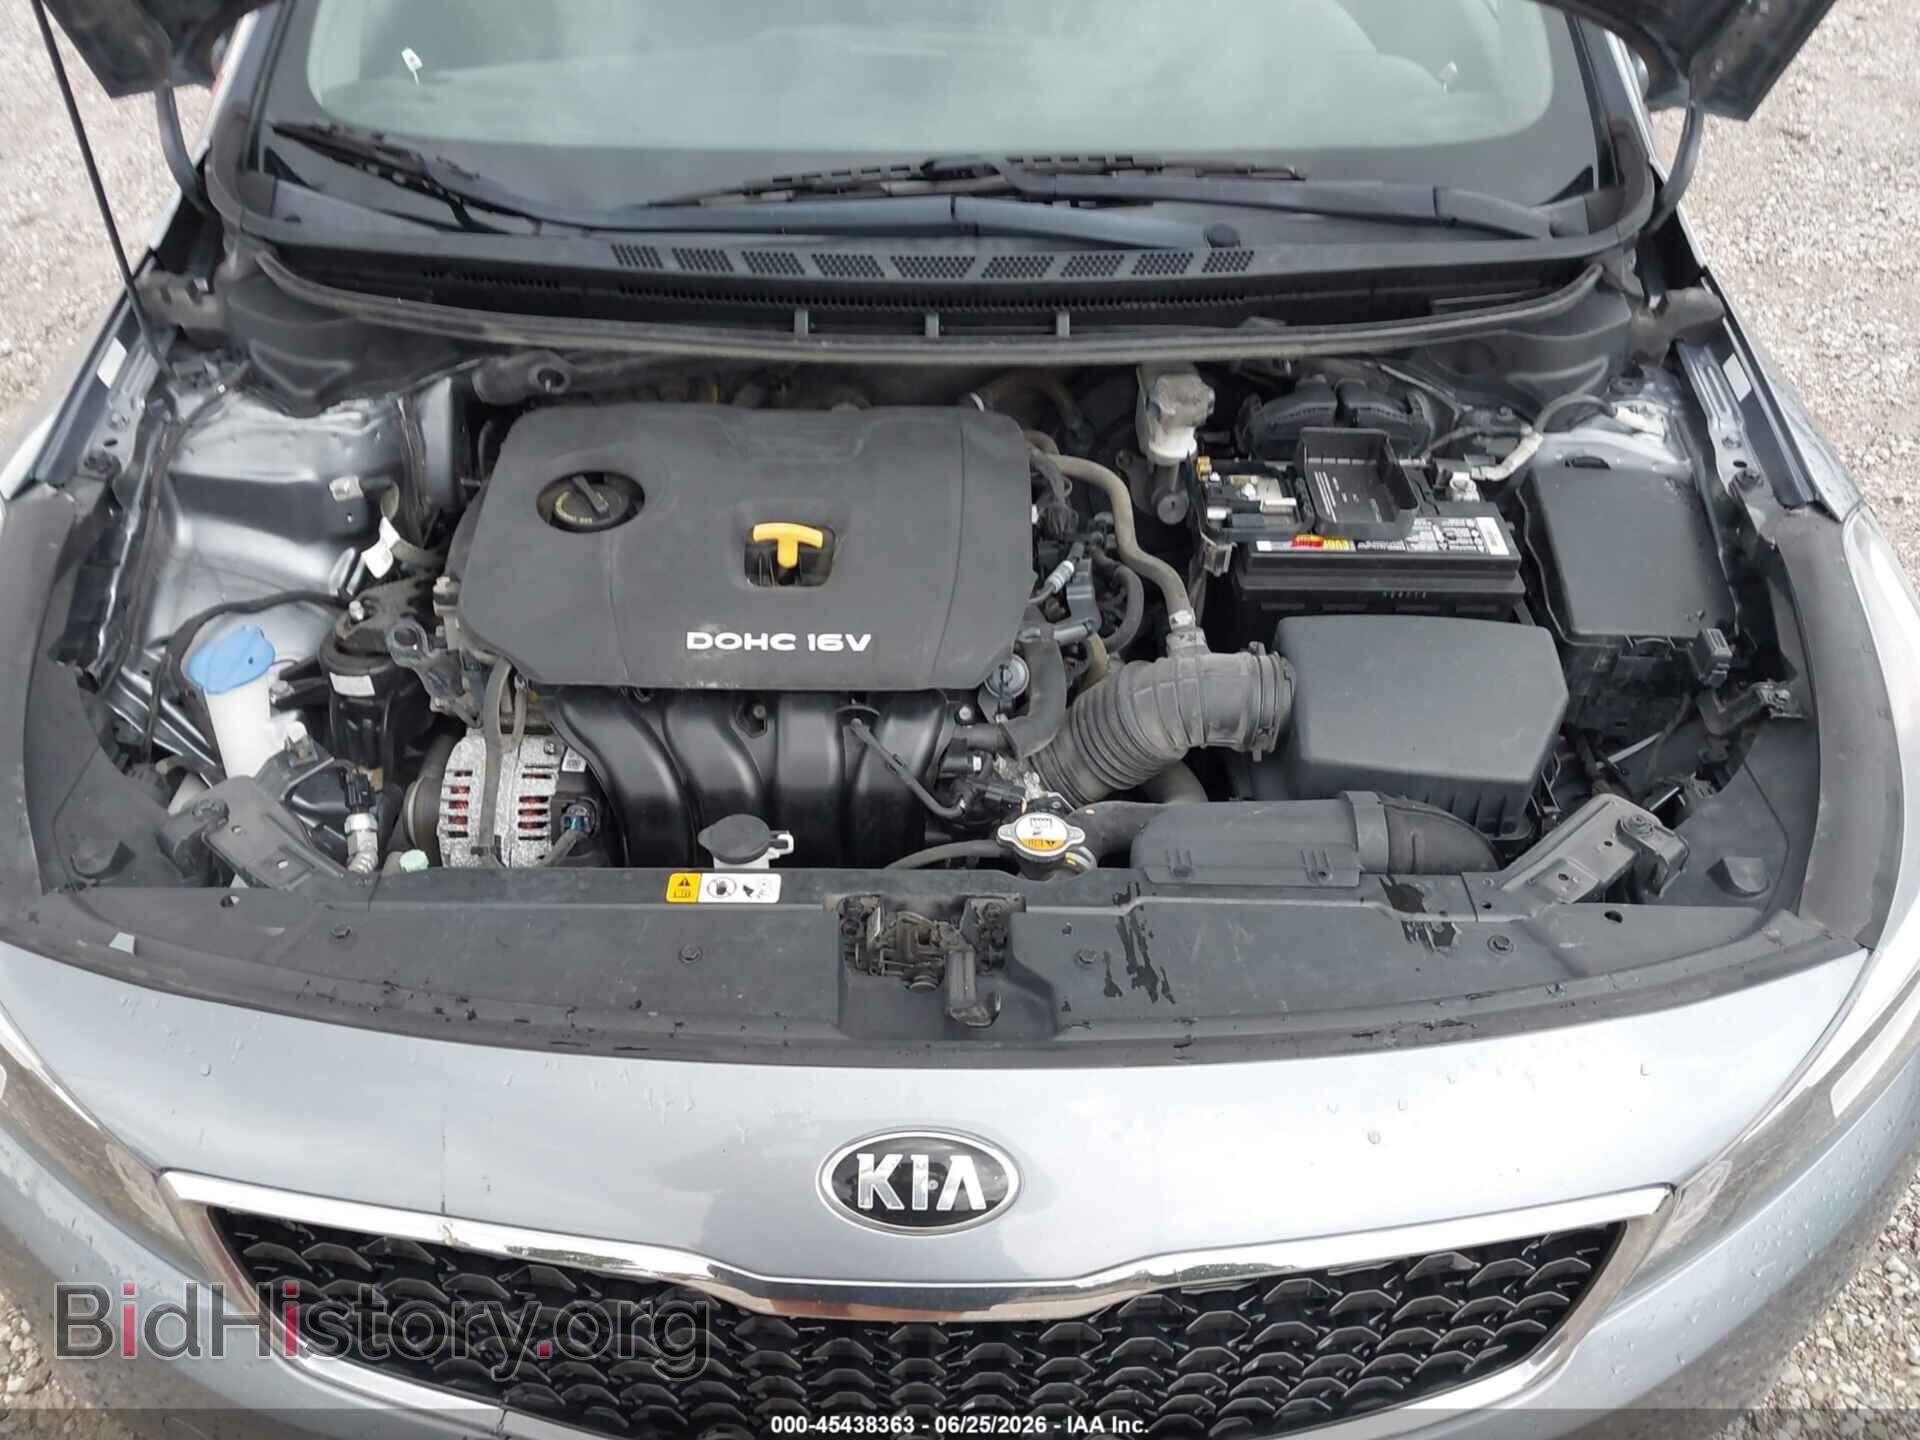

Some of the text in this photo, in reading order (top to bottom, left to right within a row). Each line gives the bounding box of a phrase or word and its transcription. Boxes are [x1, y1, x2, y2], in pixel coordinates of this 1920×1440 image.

[686, 631, 872, 652] DOHC 16V
[856, 1153, 988, 1211] KIA
